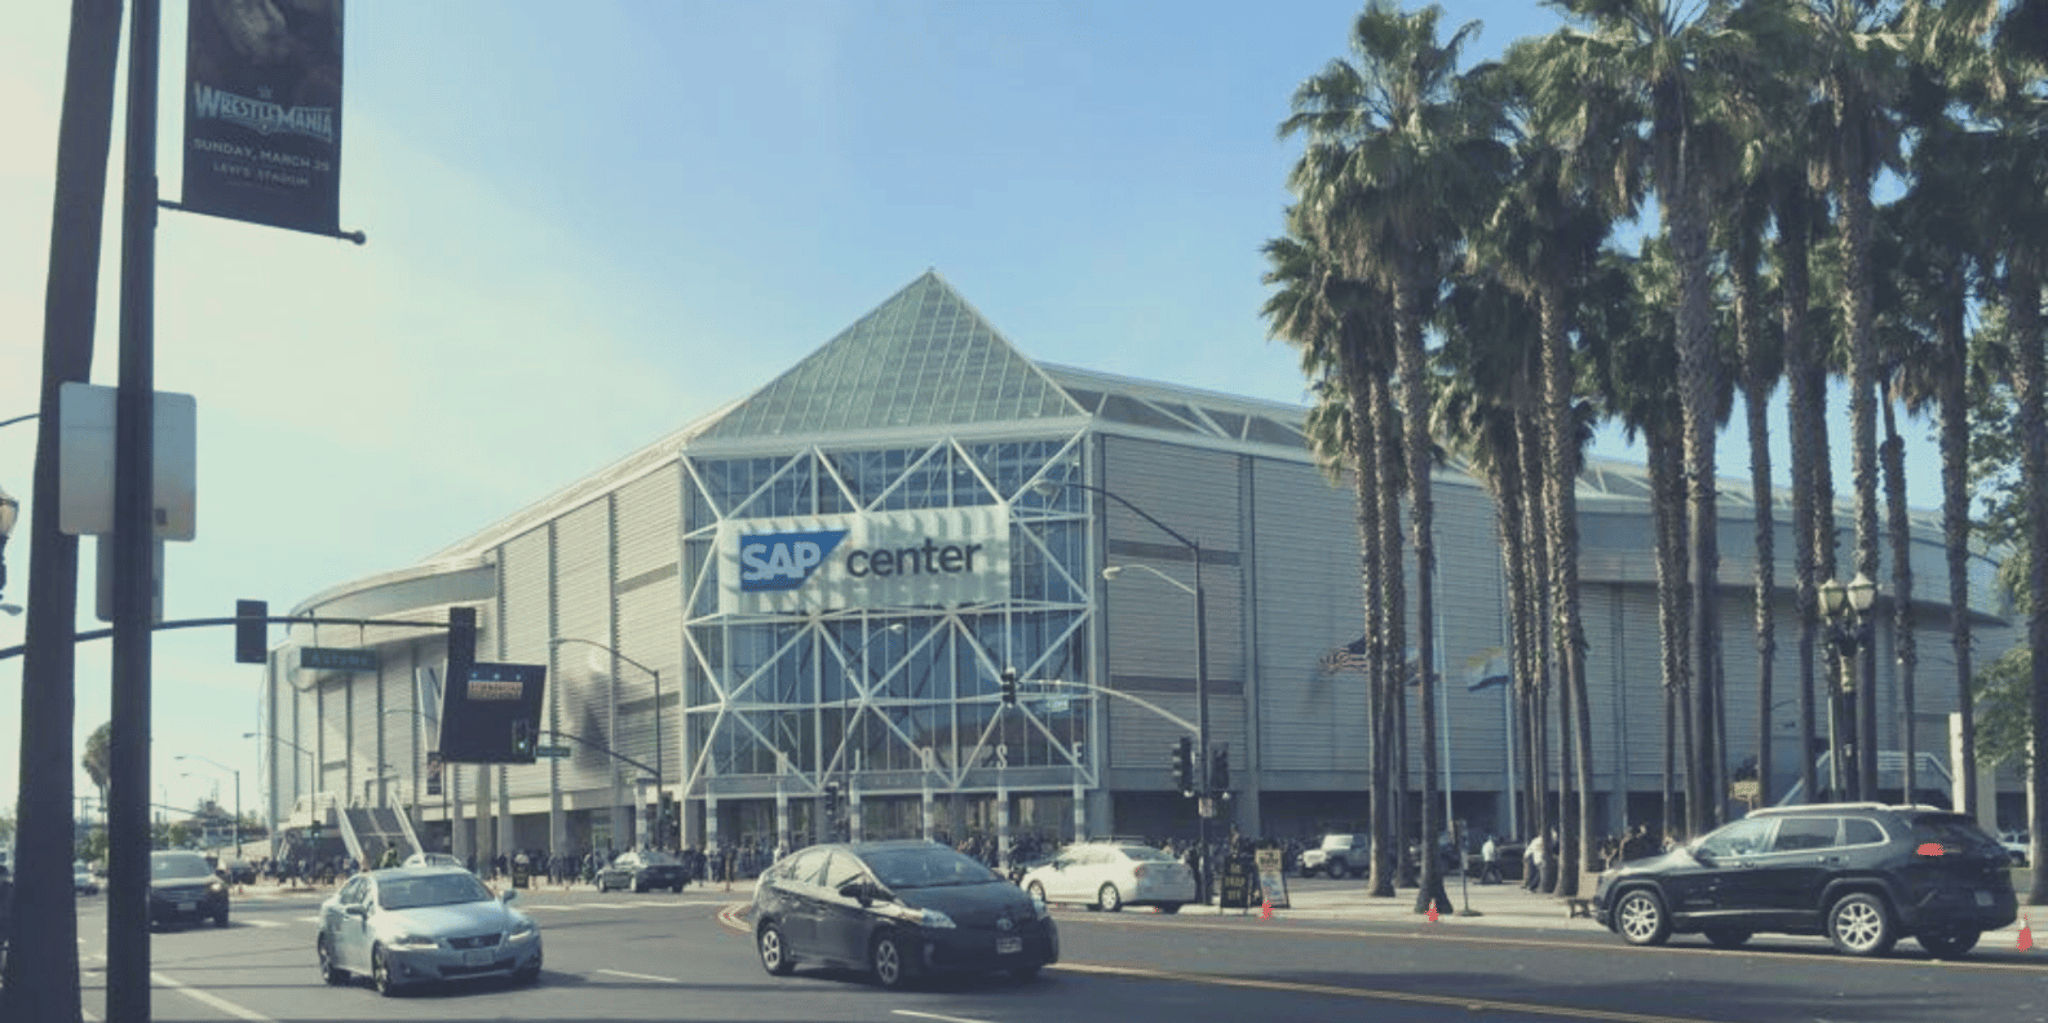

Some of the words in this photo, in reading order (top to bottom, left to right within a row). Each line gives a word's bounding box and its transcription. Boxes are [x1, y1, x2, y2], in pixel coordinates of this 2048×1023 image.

[260, 151, 310, 168] MARCH
[742, 541, 822, 582] SAP
[846, 538, 982, 578] center
